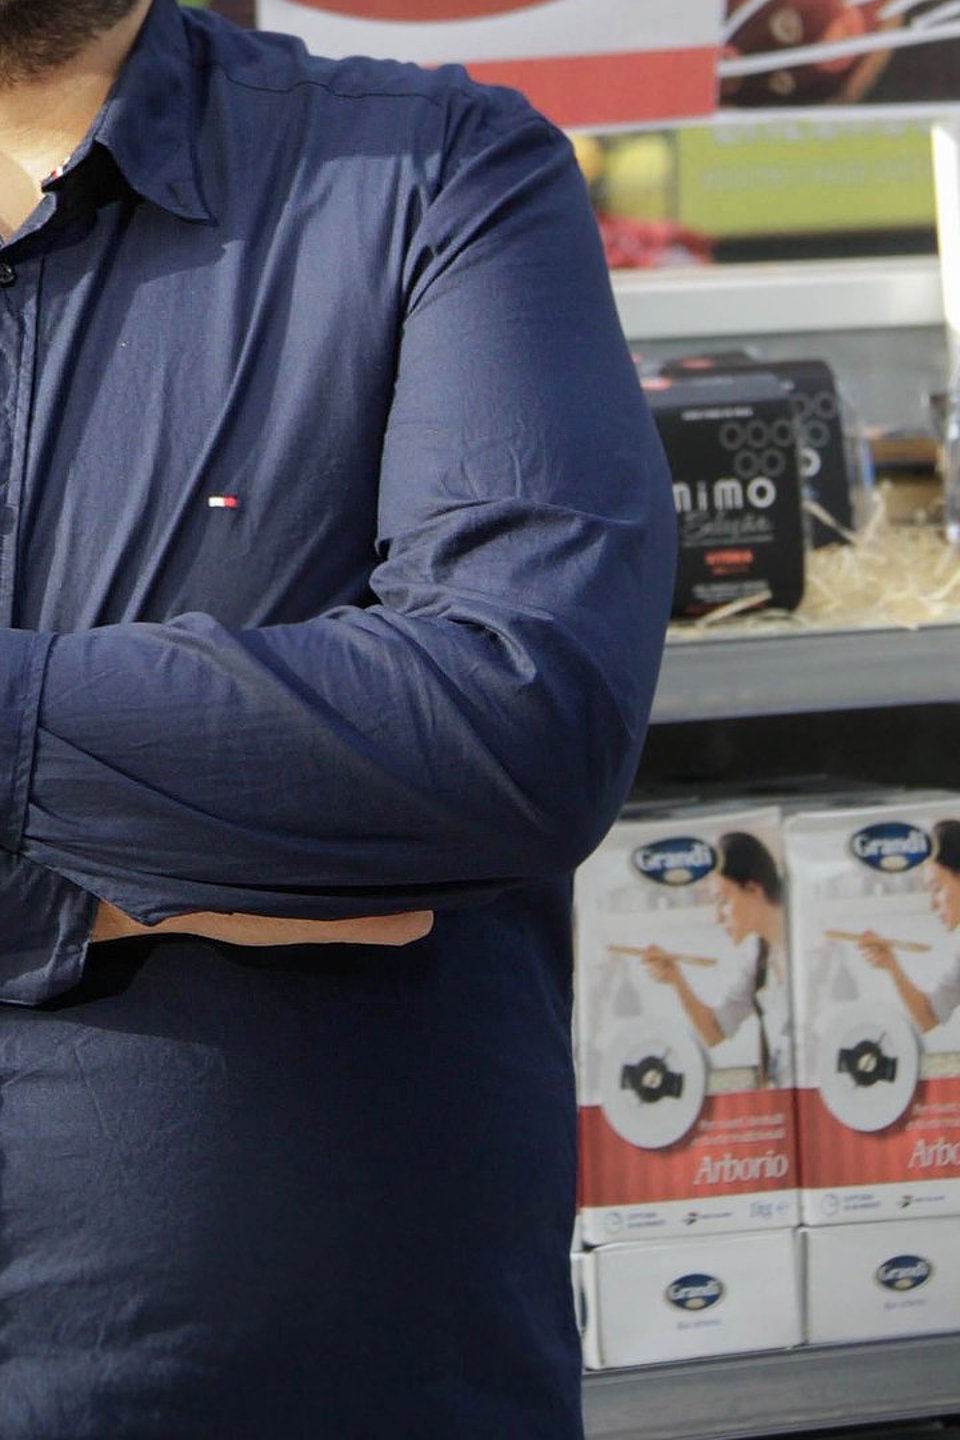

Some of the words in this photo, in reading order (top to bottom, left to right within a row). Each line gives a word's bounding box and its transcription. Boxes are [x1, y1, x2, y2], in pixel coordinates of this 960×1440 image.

[635, 843, 712, 872] Grandi
[854, 829, 928, 858] Grandi
[692, 1149, 789, 1186] Arborio
